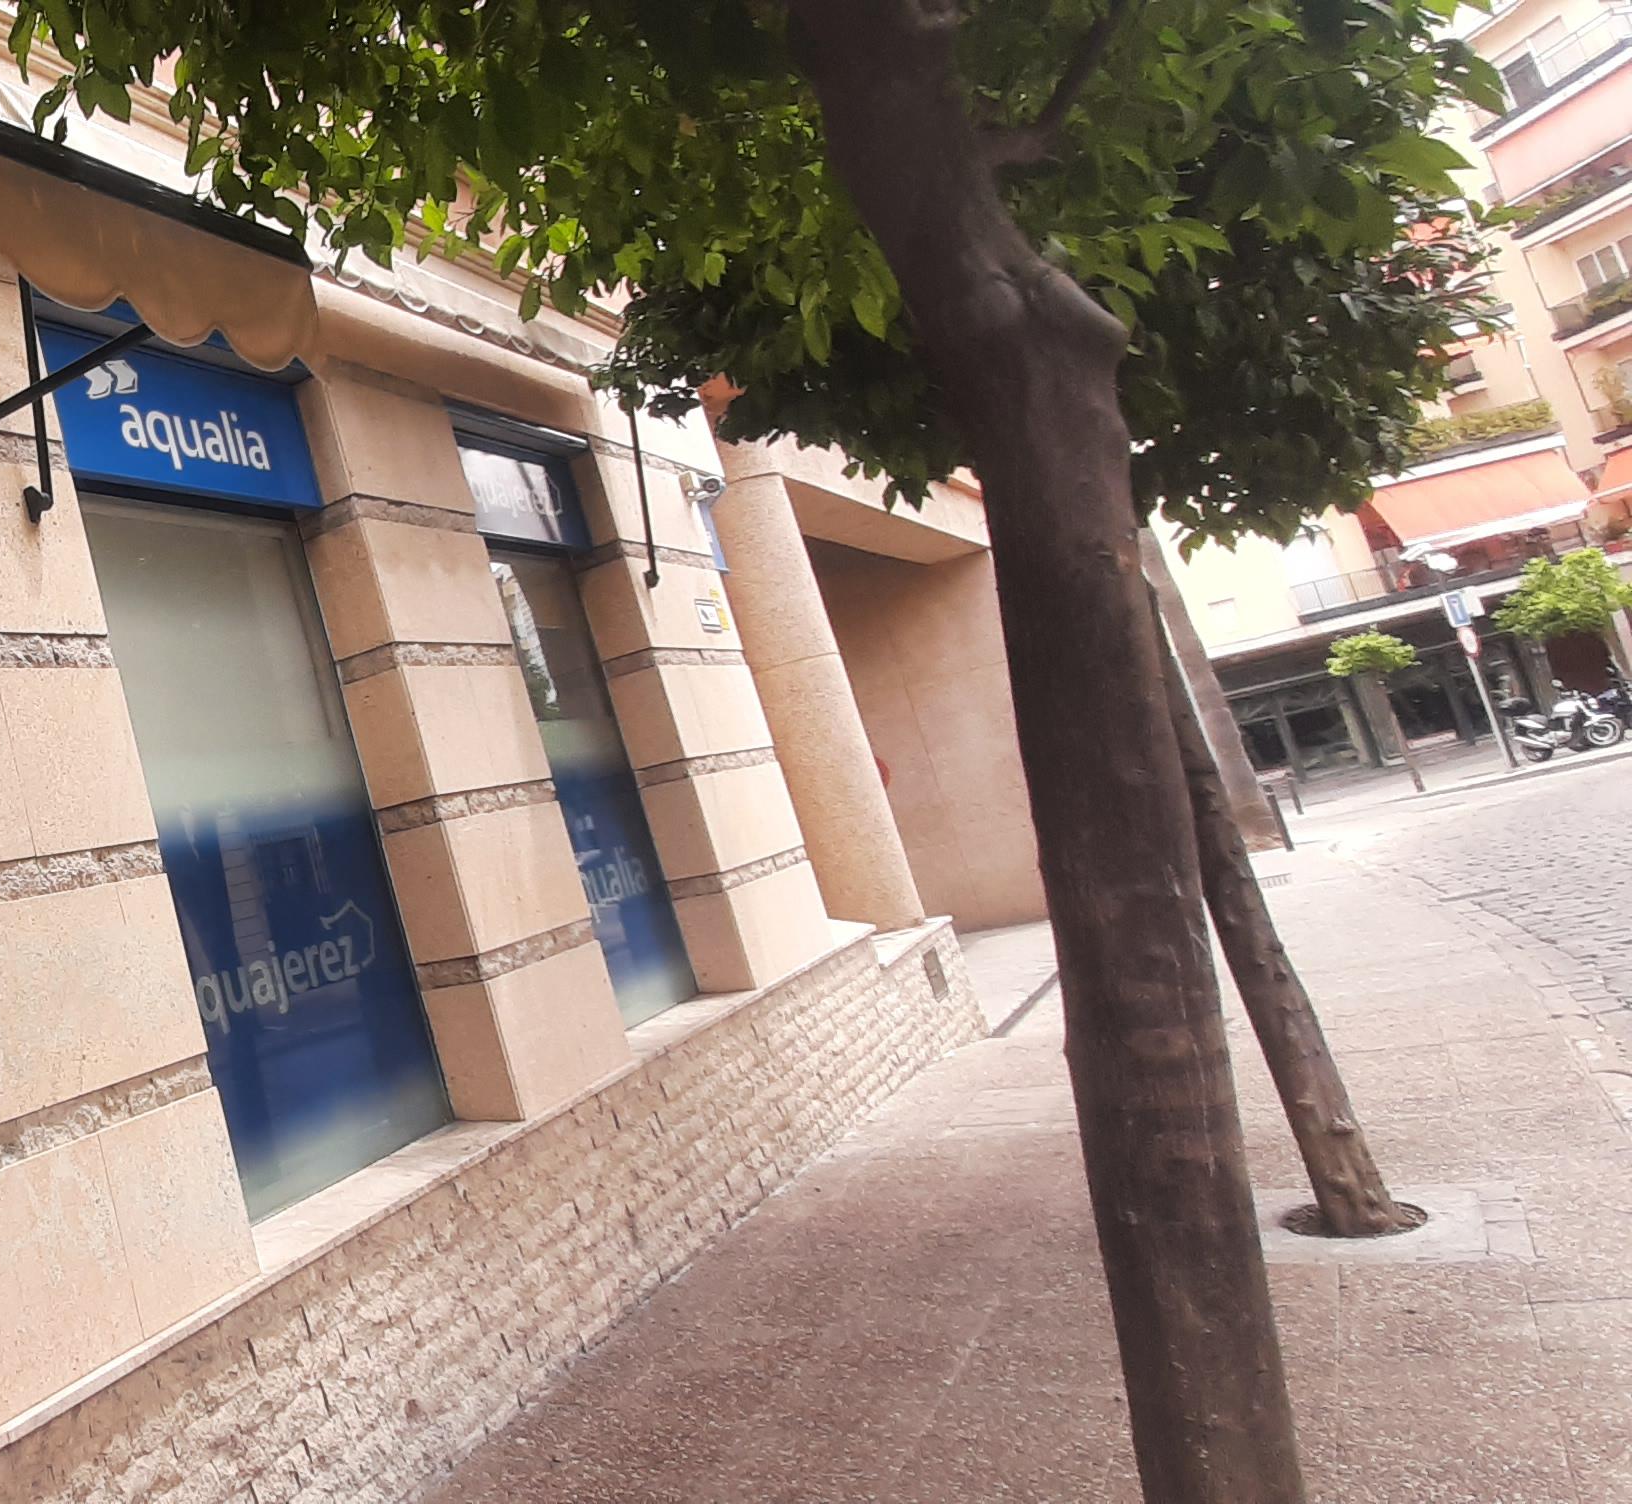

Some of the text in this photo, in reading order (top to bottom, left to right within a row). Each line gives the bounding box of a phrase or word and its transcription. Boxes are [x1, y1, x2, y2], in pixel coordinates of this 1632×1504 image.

[120, 404, 271, 471] aqualia
[469, 478, 556, 518] quajerez
[580, 846, 649, 924] qualia
[196, 935, 361, 1034] quajerez
